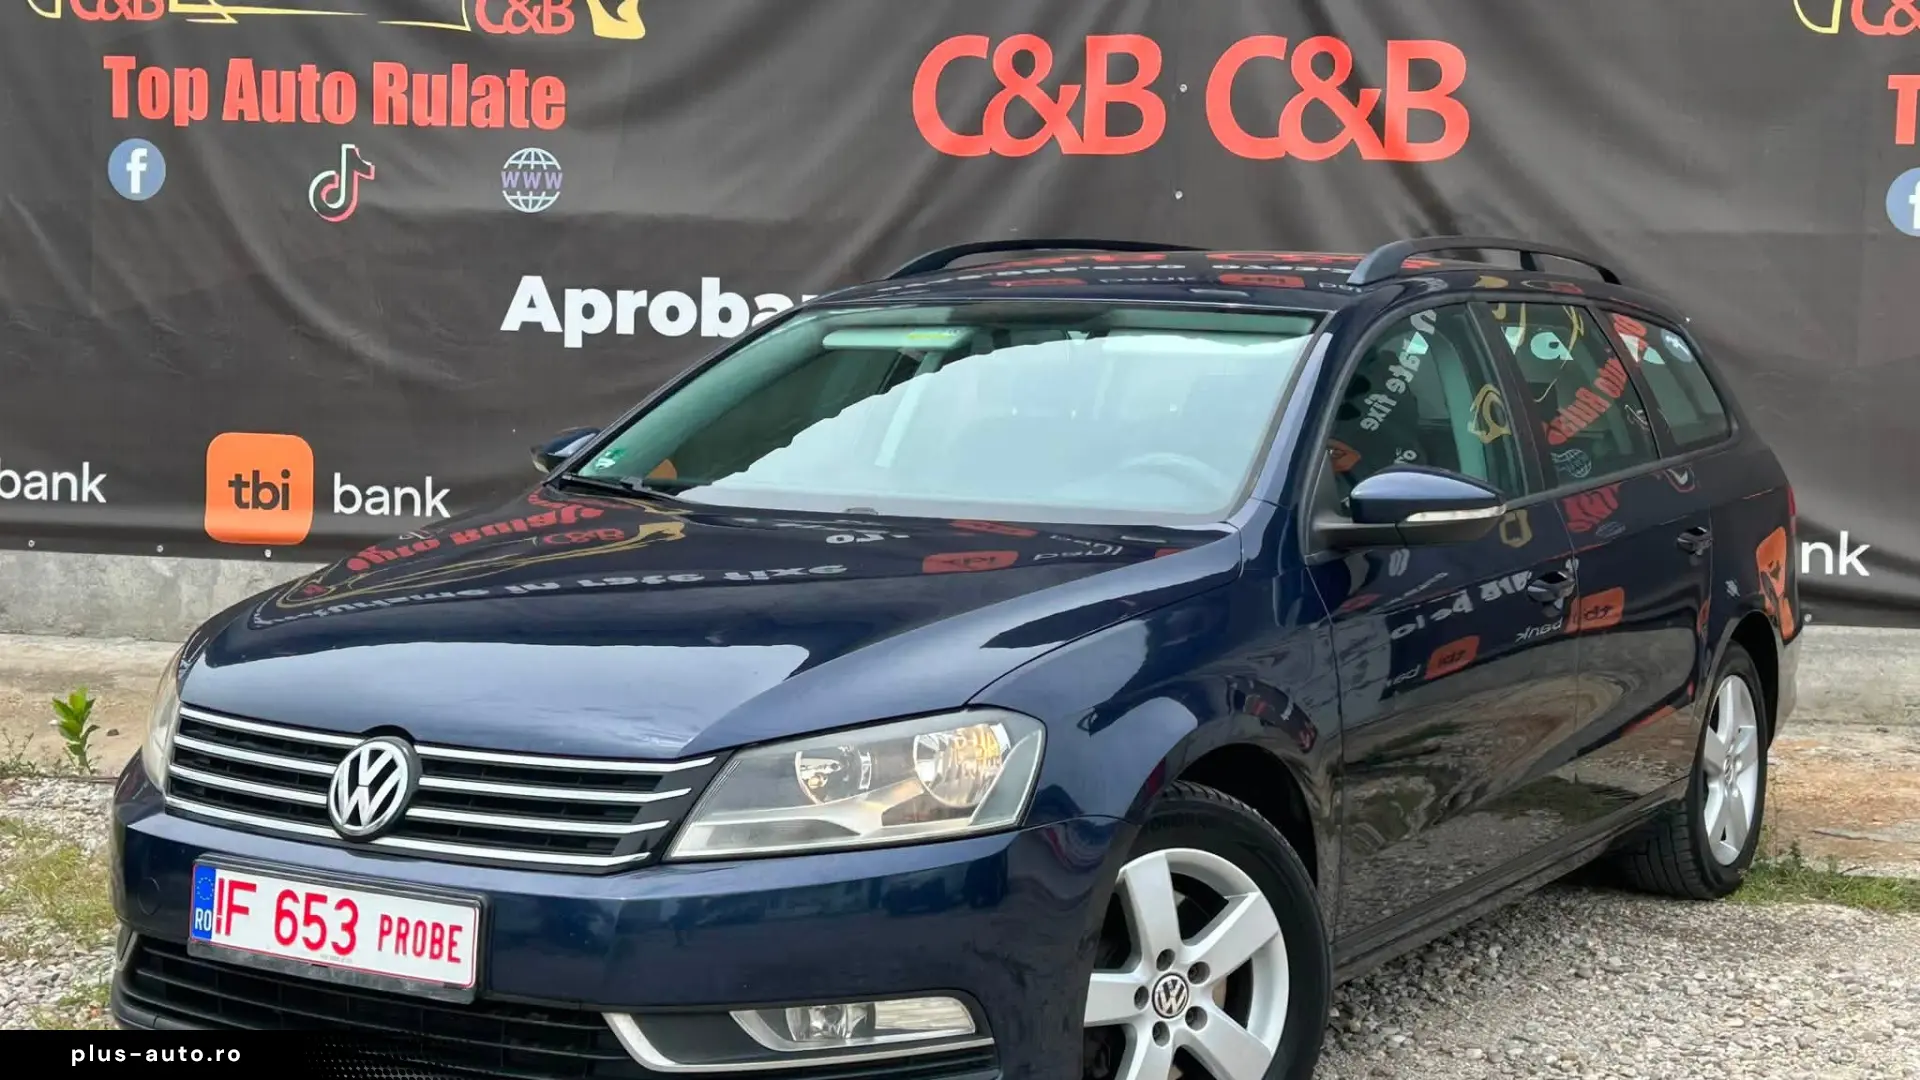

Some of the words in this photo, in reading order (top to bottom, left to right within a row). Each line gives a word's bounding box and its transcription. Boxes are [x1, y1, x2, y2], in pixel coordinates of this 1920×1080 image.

[1850, 0, 1920, 36] C&
[102, 55, 209, 127] Top
[221, 57, 358, 125] Auto
[372, 61, 567, 130] Rulate
[912, 33, 1167, 158] C&B
[1205, 34, 1471, 163] C&B
[500, 275, 819, 348] Aproba
[228, 469, 290, 511] tbi
[333, 472, 451, 518] bank
[1801, 530, 1870, 577] nk
[194, 907, 213, 932] RO
[215, 877, 258, 936] IF
[273, 888, 360, 957] 653
[377, 913, 464, 964] PROBE
